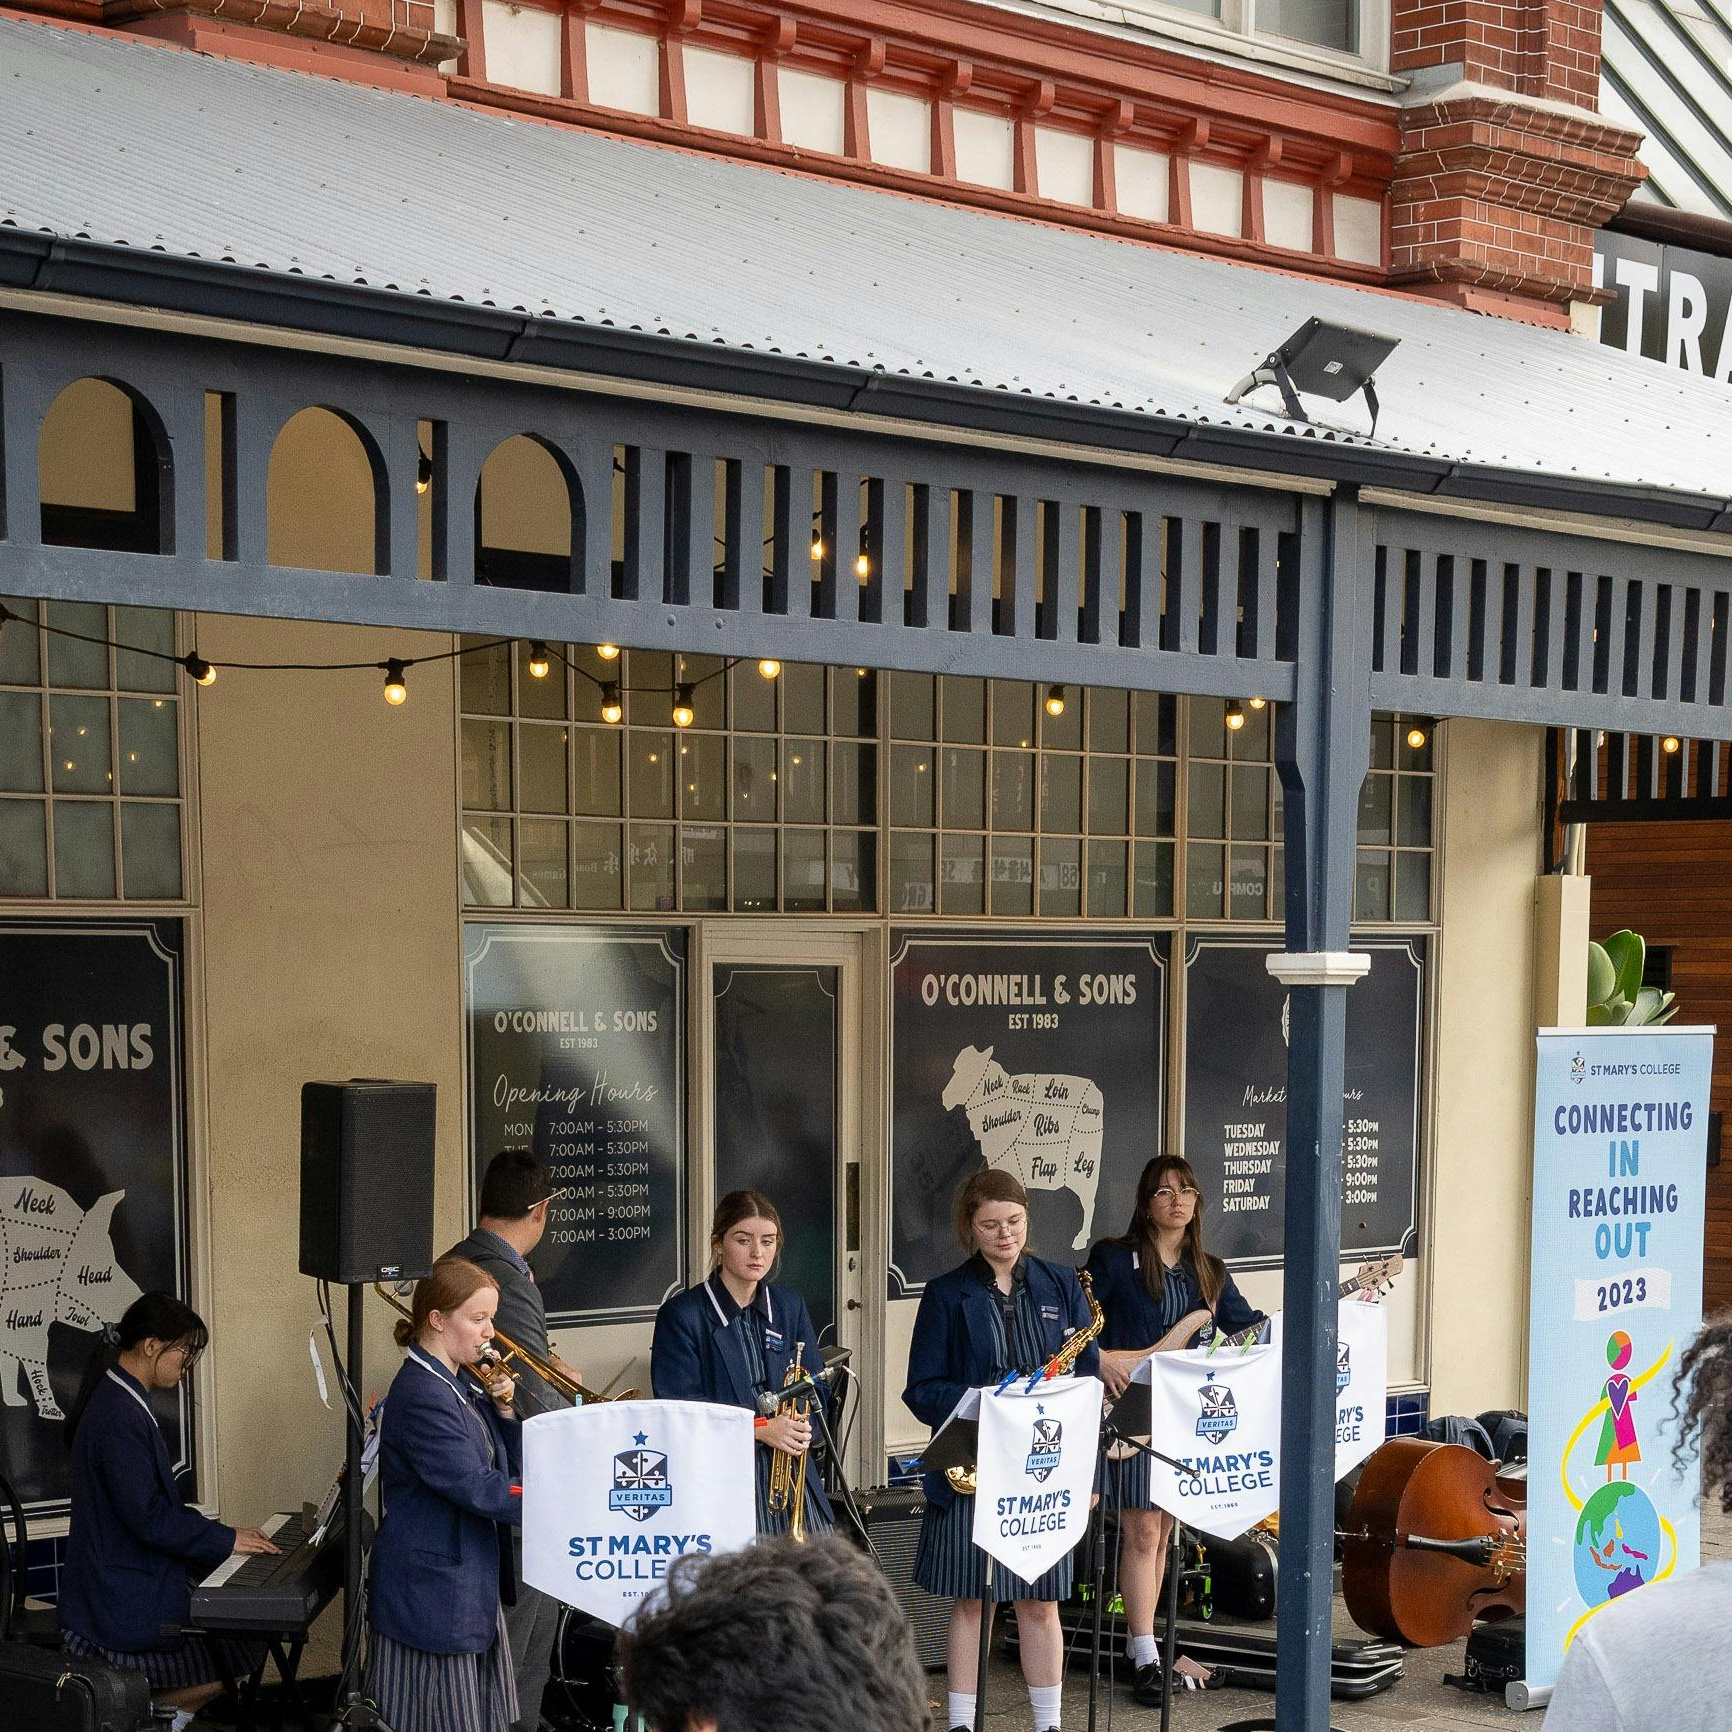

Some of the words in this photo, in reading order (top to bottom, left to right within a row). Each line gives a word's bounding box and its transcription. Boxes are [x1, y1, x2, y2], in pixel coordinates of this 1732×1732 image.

[921, 974, 1047, 1006] O'CONNELL
[1054, 975, 1071, 1004] &
[1079, 974, 1137, 1005] SONS
[494, 1010, 588, 1034] O'CONNELL
[594, 1011, 607, 1032] &
[613, 1010, 658, 1033] SONS
[1008, 1014, 1029, 1030] EST
[1032, 1013, 1059, 1029] 1983
[42, 1023, 154, 1071] SONS
[560, 1038, 575, 1049] EST
[578, 1037, 599, 1048] 1983
[1590, 1065, 1602, 1076] ST
[1603, 1064, 1638, 1076] MARY'S
[1639, 1063, 1681, 1075] COLLEGE
[493, 1073, 586, 1114] Opening
[590, 1070, 659, 1107] Hours
[983, 1074, 1004, 1097] Neck
[1012, 1079, 1031, 1095] Rack
[1044, 1077, 1069, 1100] Loin
[1243, 1085, 1287, 1107] Market
[504, 1123, 533, 1137] MON
[549, 1121, 595, 1134] 7:00AM
[606, 1120, 649, 1134] 5:30PM
[981, 1108, 1023, 1133] Shoulder
[1033, 1112, 1060, 1137] Ribs
[1224, 1123, 1266, 1139] TUESDAY
[1347, 1119, 1379, 1133] 5:30PM
[1554, 1101, 1693, 1136] CONNECTING
[549, 1143, 595, 1157] 7:00AM
[606, 1141, 649, 1155] 5:30PM
[1224, 1140, 1281, 1158] WEDNESDAY
[1347, 1136, 1379, 1151] 5:30PM
[1073, 1150, 1095, 1179] Leg
[1224, 1158, 1273, 1175] THURSDAY
[1347, 1154, 1378, 1169] 5:30PM
[1609, 1139, 1640, 1178] IN
[549, 1164, 595, 1178] 7:00AM
[607, 1162, 649, 1176] 5:30PM
[1031, 1156, 1058, 1184] Flap
[607, 1183, 649, 1197] 5:30PM
[1223, 1178, 1256, 1194] FRIDAY
[1345, 1172, 1378, 1187] 9:00PM
[13, 1187, 57, 1215] Neck
[1222, 1195, 1271, 1212] SATURDAY
[1345, 1190, 1378, 1205] 3:00PM
[1568, 1183, 1679, 1218] REACHING
[550, 1208, 595, 1222] 7:00AM
[607, 1205, 651, 1219] 9:00PM
[551, 1229, 595, 1243] 7:00AM
[608, 1226, 651, 1241] 3:00PM
[1594, 1221, 1651, 1260] OUT
[13, 1248, 61, 1264] Shoulder
[77, 1265, 113, 1286] Head
[1597, 1276, 1646, 1311] 2023
[5, 1309, 44, 1331] Hand
[64, 1306, 90, 1327] Jowl
[30, 1368, 46, 1396] Hock
[1202, 1420, 1234, 1429] VERITAS
[1031, 1456, 1057, 1466] VERITAS
[1195, 1451, 1274, 1474] MARY'S
[1178, 1470, 1274, 1497] COLLEGE
[616, 1492, 666, 1502] VERITAS
[997, 1496, 1017, 1516] ST
[1018, 1489, 1071, 1515] MARY'S
[1000, 1511, 1066, 1538] COLLEGE
[568, 1536, 603, 1557] ST
[608, 1534, 712, 1556] MARY'S
[576, 1559, 666, 1581] COLLE
